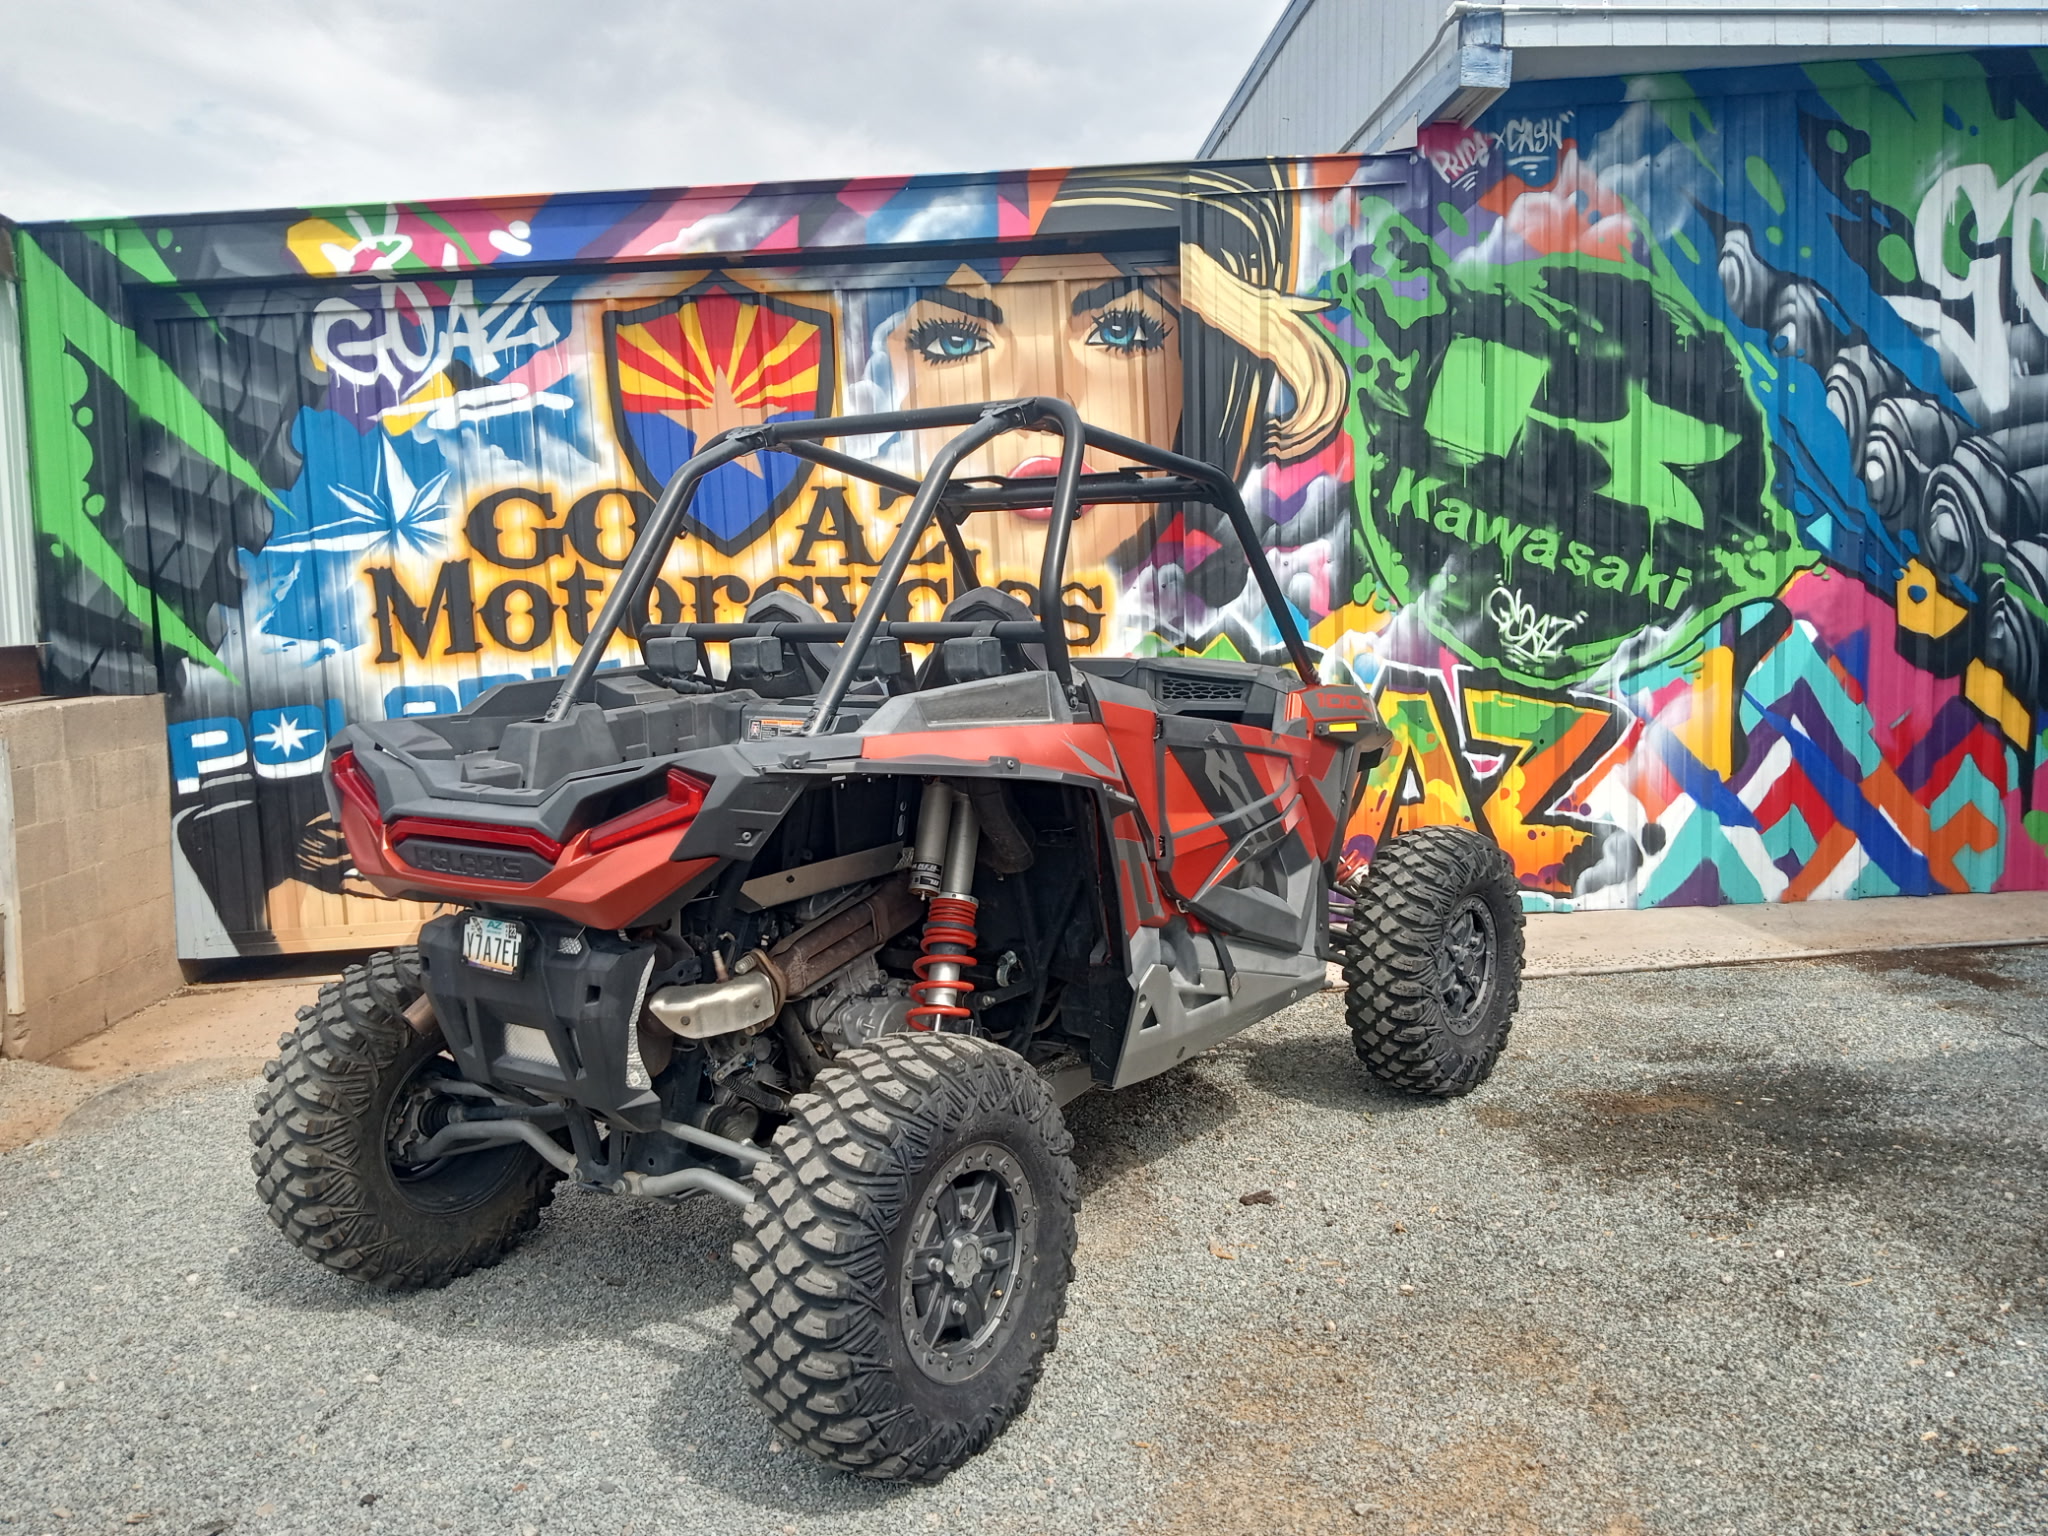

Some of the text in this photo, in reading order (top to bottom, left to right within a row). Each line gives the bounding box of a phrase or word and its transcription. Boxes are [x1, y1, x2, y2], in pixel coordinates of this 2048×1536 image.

[464, 487, 658, 570] GO
[1387, 467, 1693, 610] Kawasaki
[414, 845, 524, 881] POLARIS
